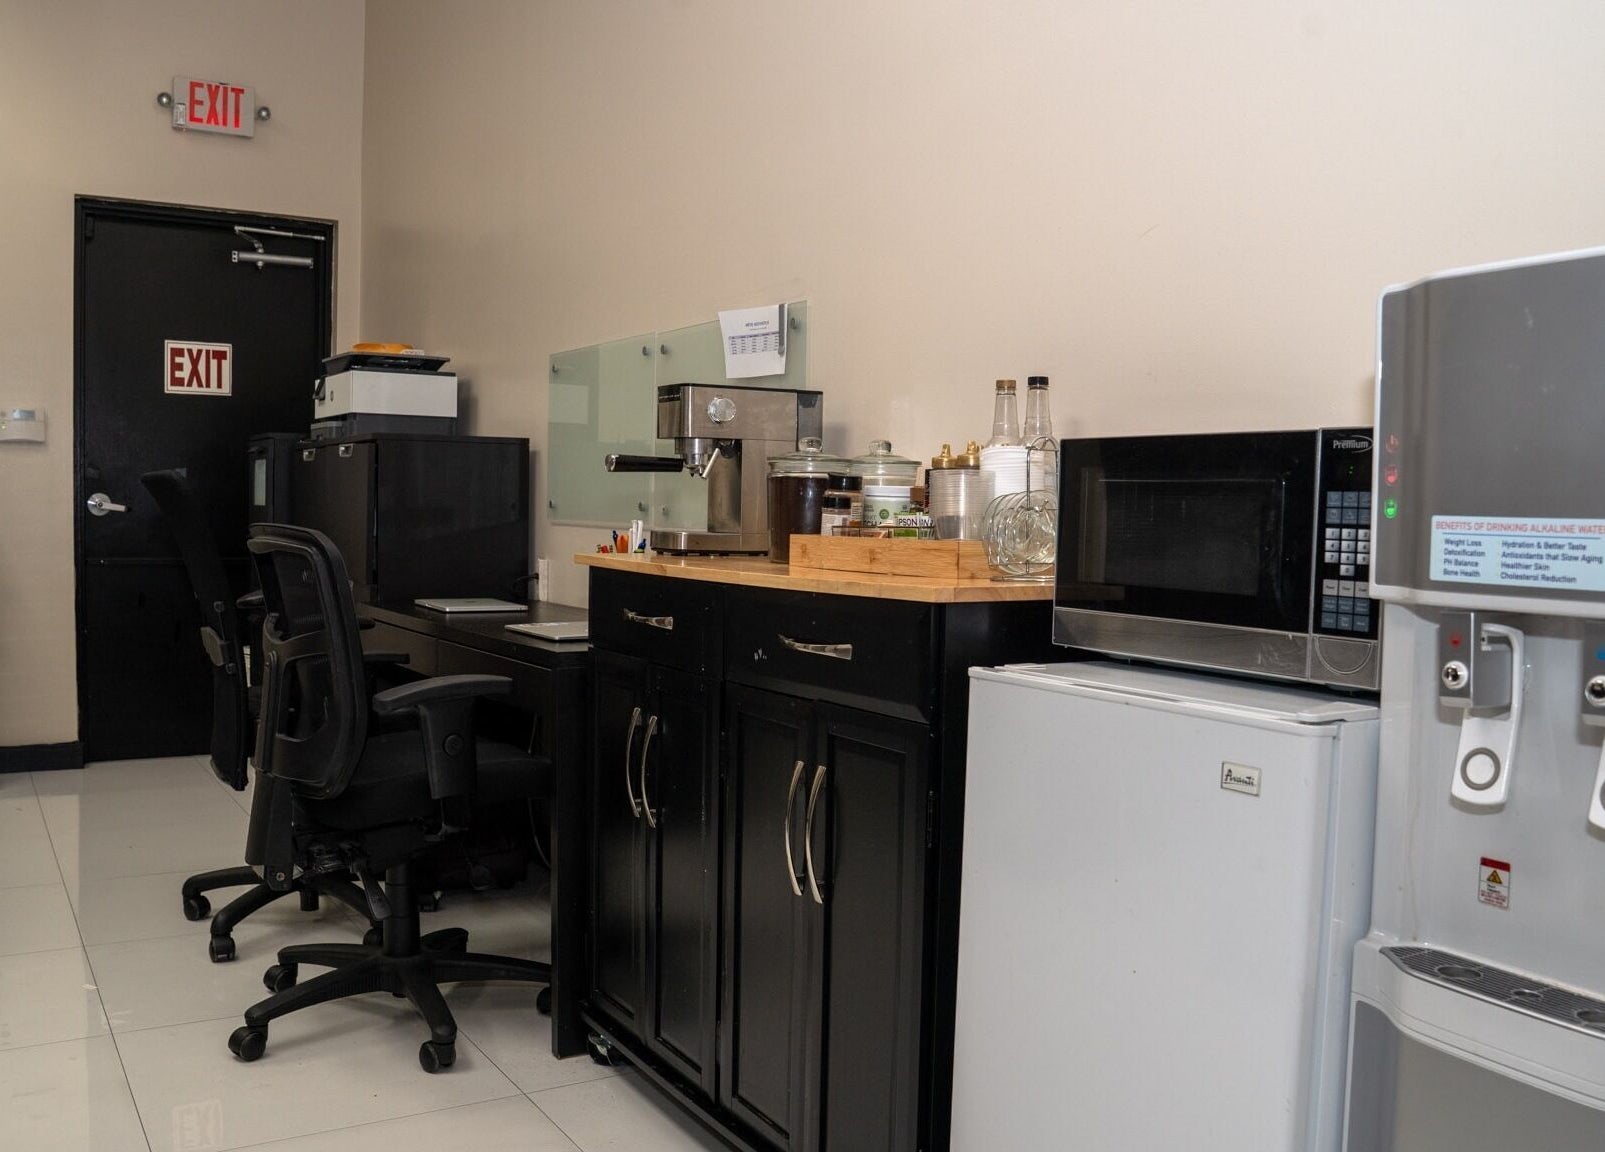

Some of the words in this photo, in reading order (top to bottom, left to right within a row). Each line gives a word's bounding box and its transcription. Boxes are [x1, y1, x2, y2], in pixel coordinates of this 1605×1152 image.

[190, 81, 245, 129] EXIT
[170, 347, 228, 389] EXIT
[1333, 439, 1369, 449] Premium
[1436, 521, 1472, 531] BENEFITS
[1475, 522, 1485, 531] OF
[1487, 523, 1528, 532] DRINKING
[1531, 524, 1576, 533] ALKALINE
[1580, 525, 1605, 534] WATE
[1445, 538, 1465, 547] Weight
[1502, 540, 1535, 549] Hydration
[1537, 541, 1543, 549] &
[1544, 541, 1565, 550] Better
[1568, 542, 1587, 551] Taste
[1444, 548, 1486, 557] Detoxification
[1502, 551, 1543, 560] Antioxidants
[1561, 553, 1579, 561] Slow
[1581, 554, 1604, 564] Aging
[1454, 558, 1479, 567] Balance
[1501, 562, 1533, 570] Healthier
[1534, 562, 1550, 571] Skin
[1443, 568, 1459, 576] Bone
[1460, 569, 1481, 577] Health
[1500, 571, 1540, 581] Cholesterol
[1541, 573, 1577, 583] Reduction
[1225, 768, 1255, 787] Avanti
